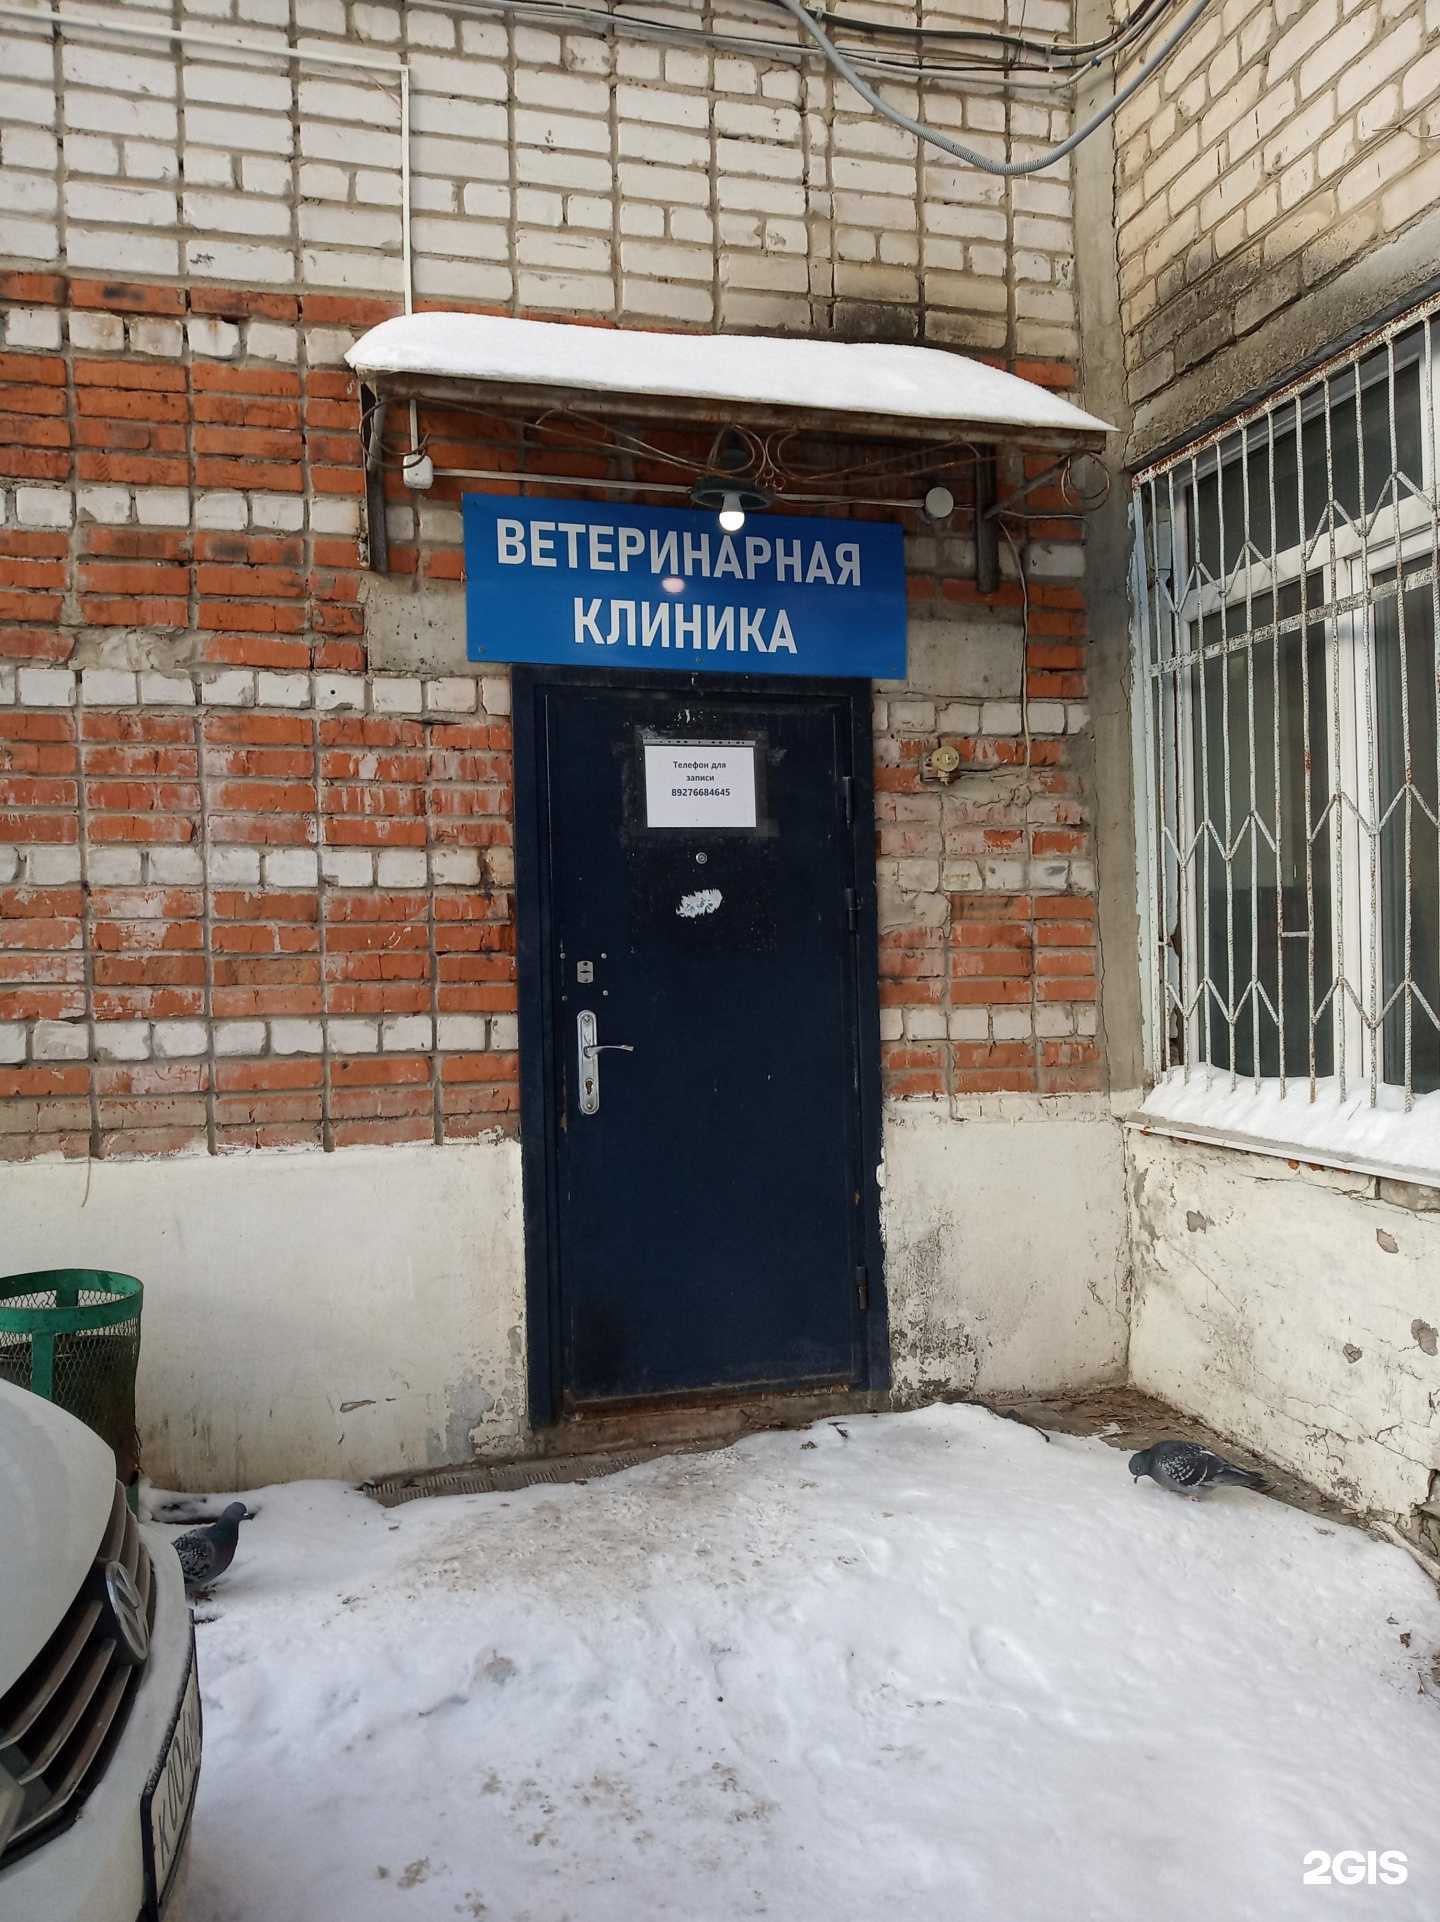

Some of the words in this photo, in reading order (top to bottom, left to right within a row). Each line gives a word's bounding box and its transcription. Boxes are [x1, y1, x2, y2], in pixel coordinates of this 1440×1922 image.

[497, 518, 861, 586] ВЕТЕРИНАРНАЯ
[574, 597, 798, 654] КЛИНИКА
[672, 760, 709, 770] Телефон
[710, 762, 727, 770] для
[671, 788, 731, 797] 89276684645
